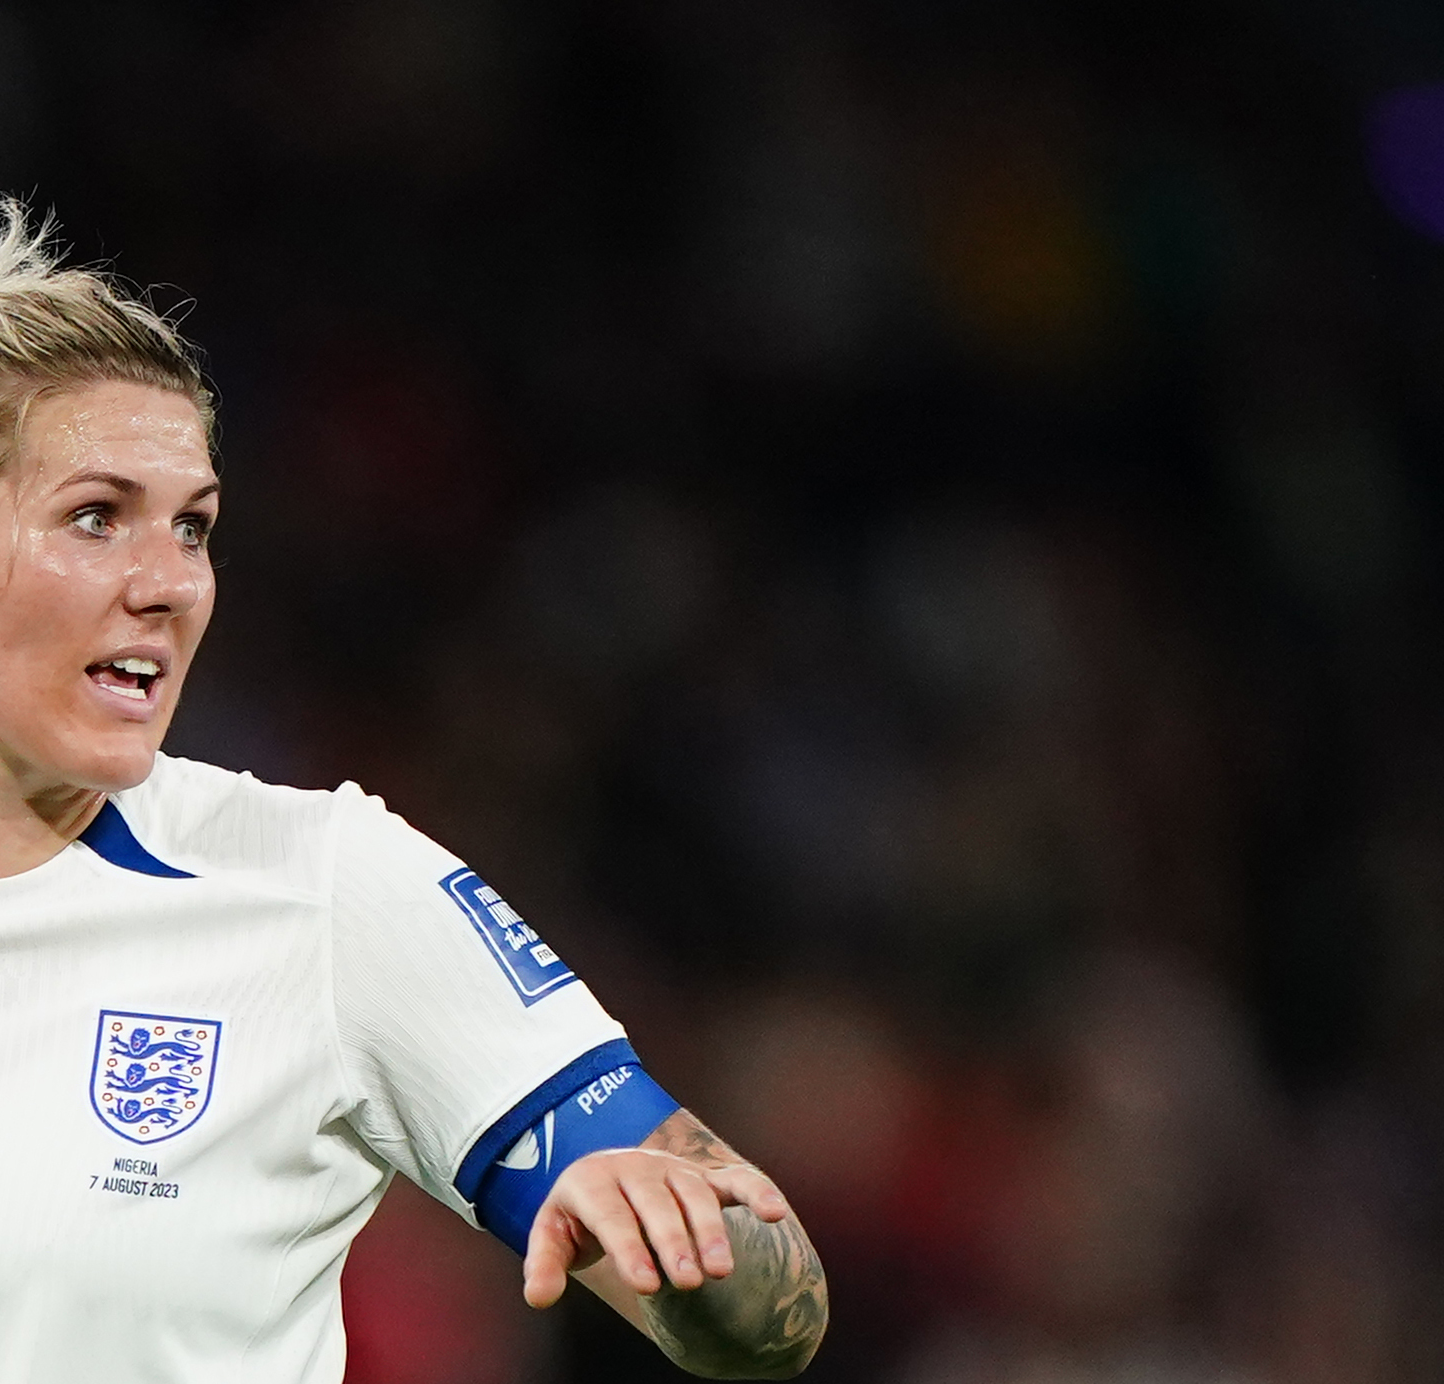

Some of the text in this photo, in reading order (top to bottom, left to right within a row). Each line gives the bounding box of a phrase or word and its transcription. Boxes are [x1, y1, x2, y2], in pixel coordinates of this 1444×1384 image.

[113, 1157, 158, 1177] NIGERIA
[89, 1175, 179, 1199] 7 AUGUST 2023
